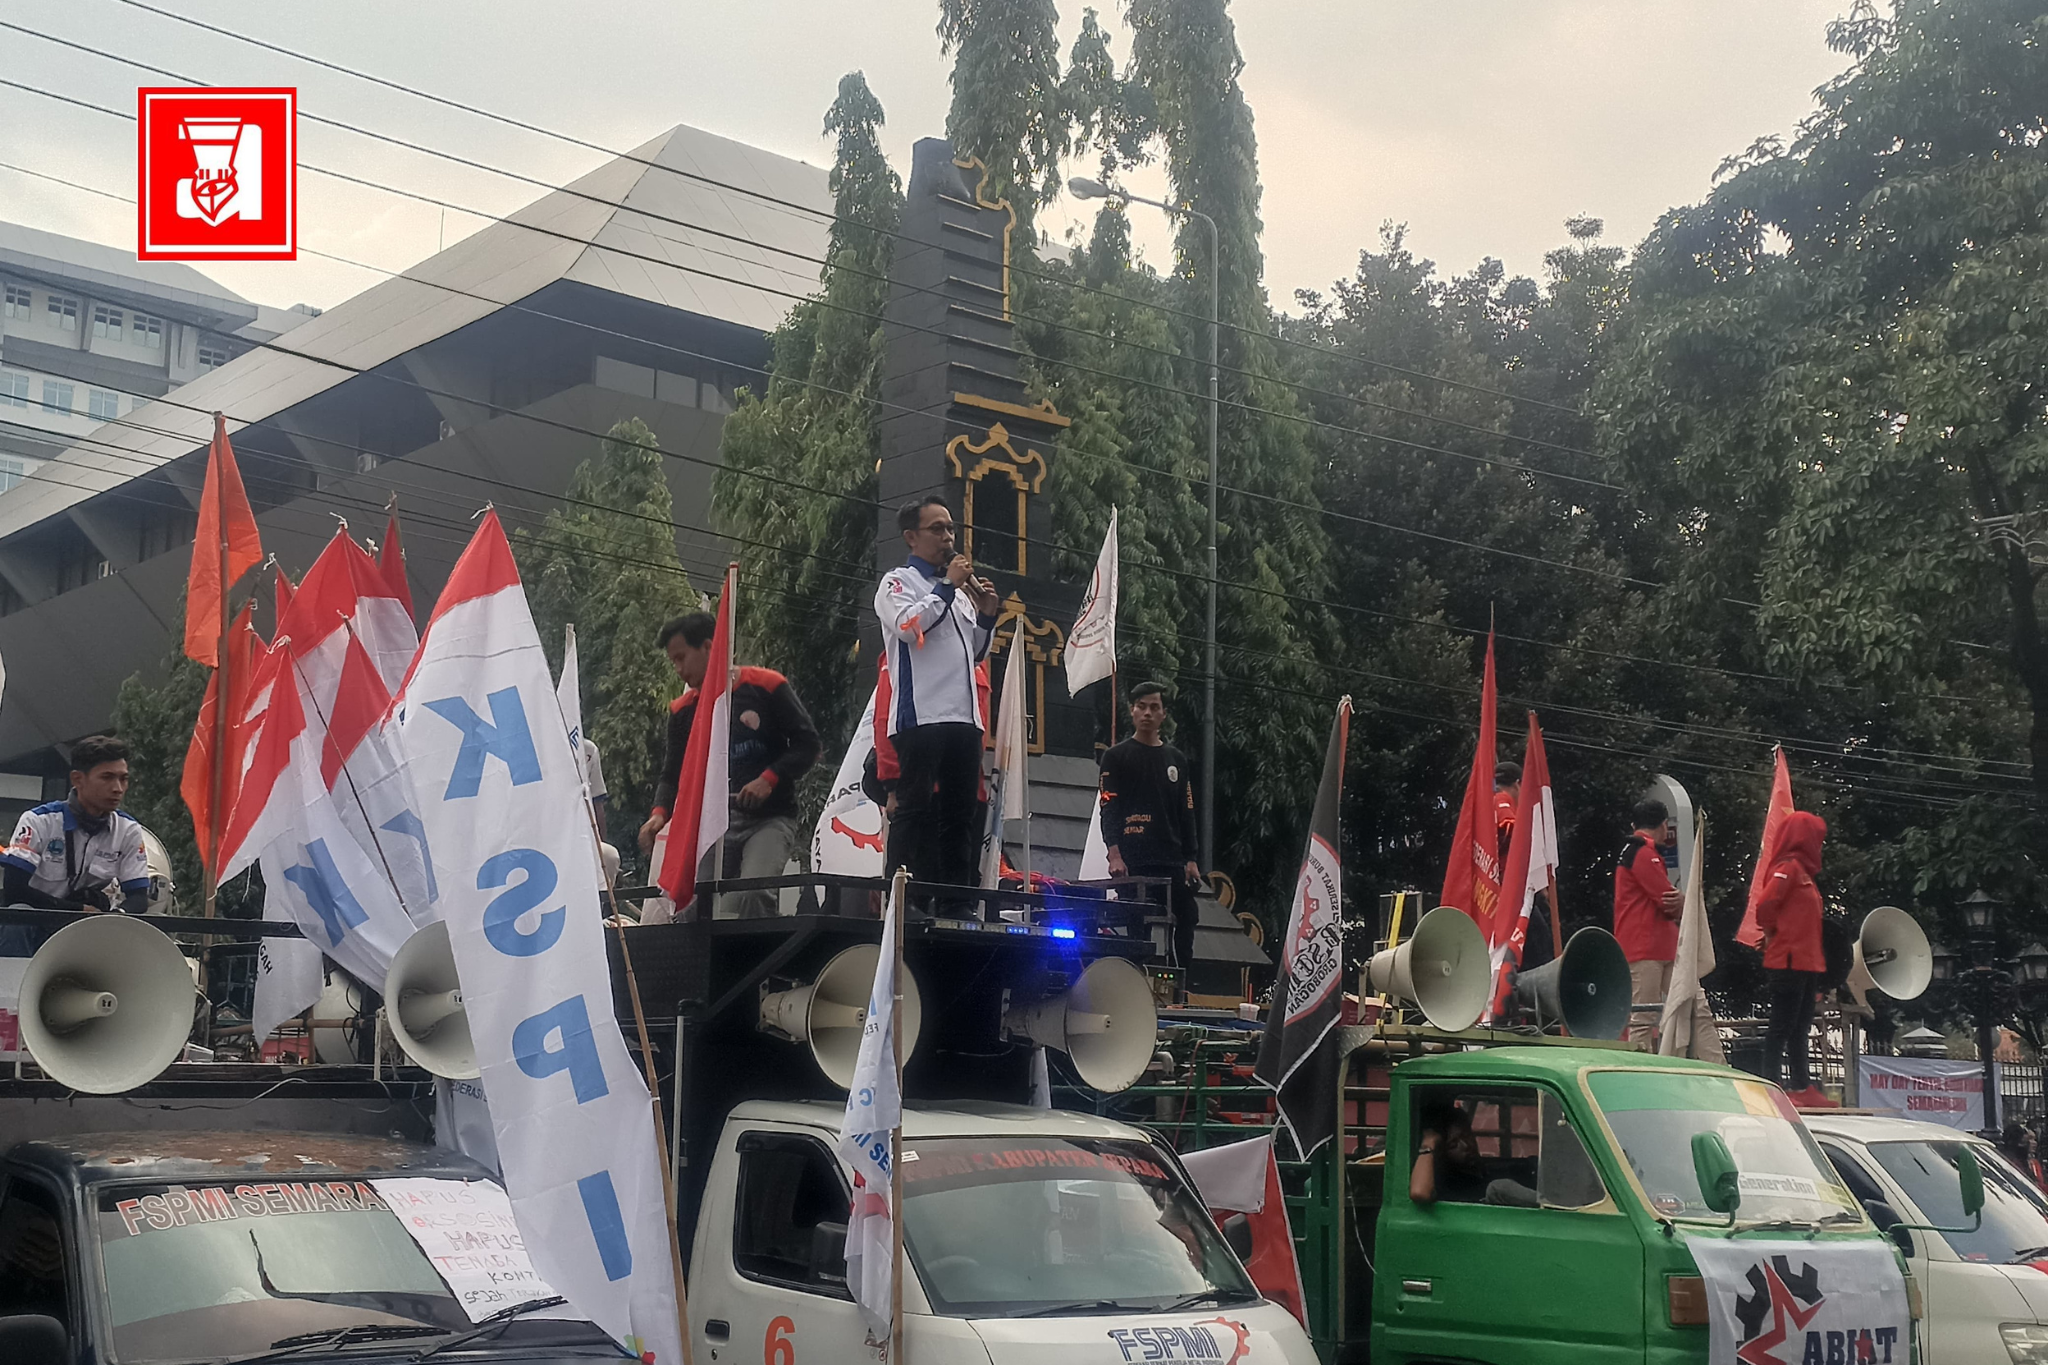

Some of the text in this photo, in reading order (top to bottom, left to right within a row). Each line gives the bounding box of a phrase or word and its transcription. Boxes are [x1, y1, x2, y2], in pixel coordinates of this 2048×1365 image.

[1738, 1174, 1816, 1195] Generation
[115, 1181, 392, 1236] FSPMI SEMARA
[389, 1189, 478, 1210] HAPUS
[486, 1270, 543, 1285] KONT
[763, 1315, 796, 1365] 6
[1109, 1326, 1222, 1362] FSPMI
